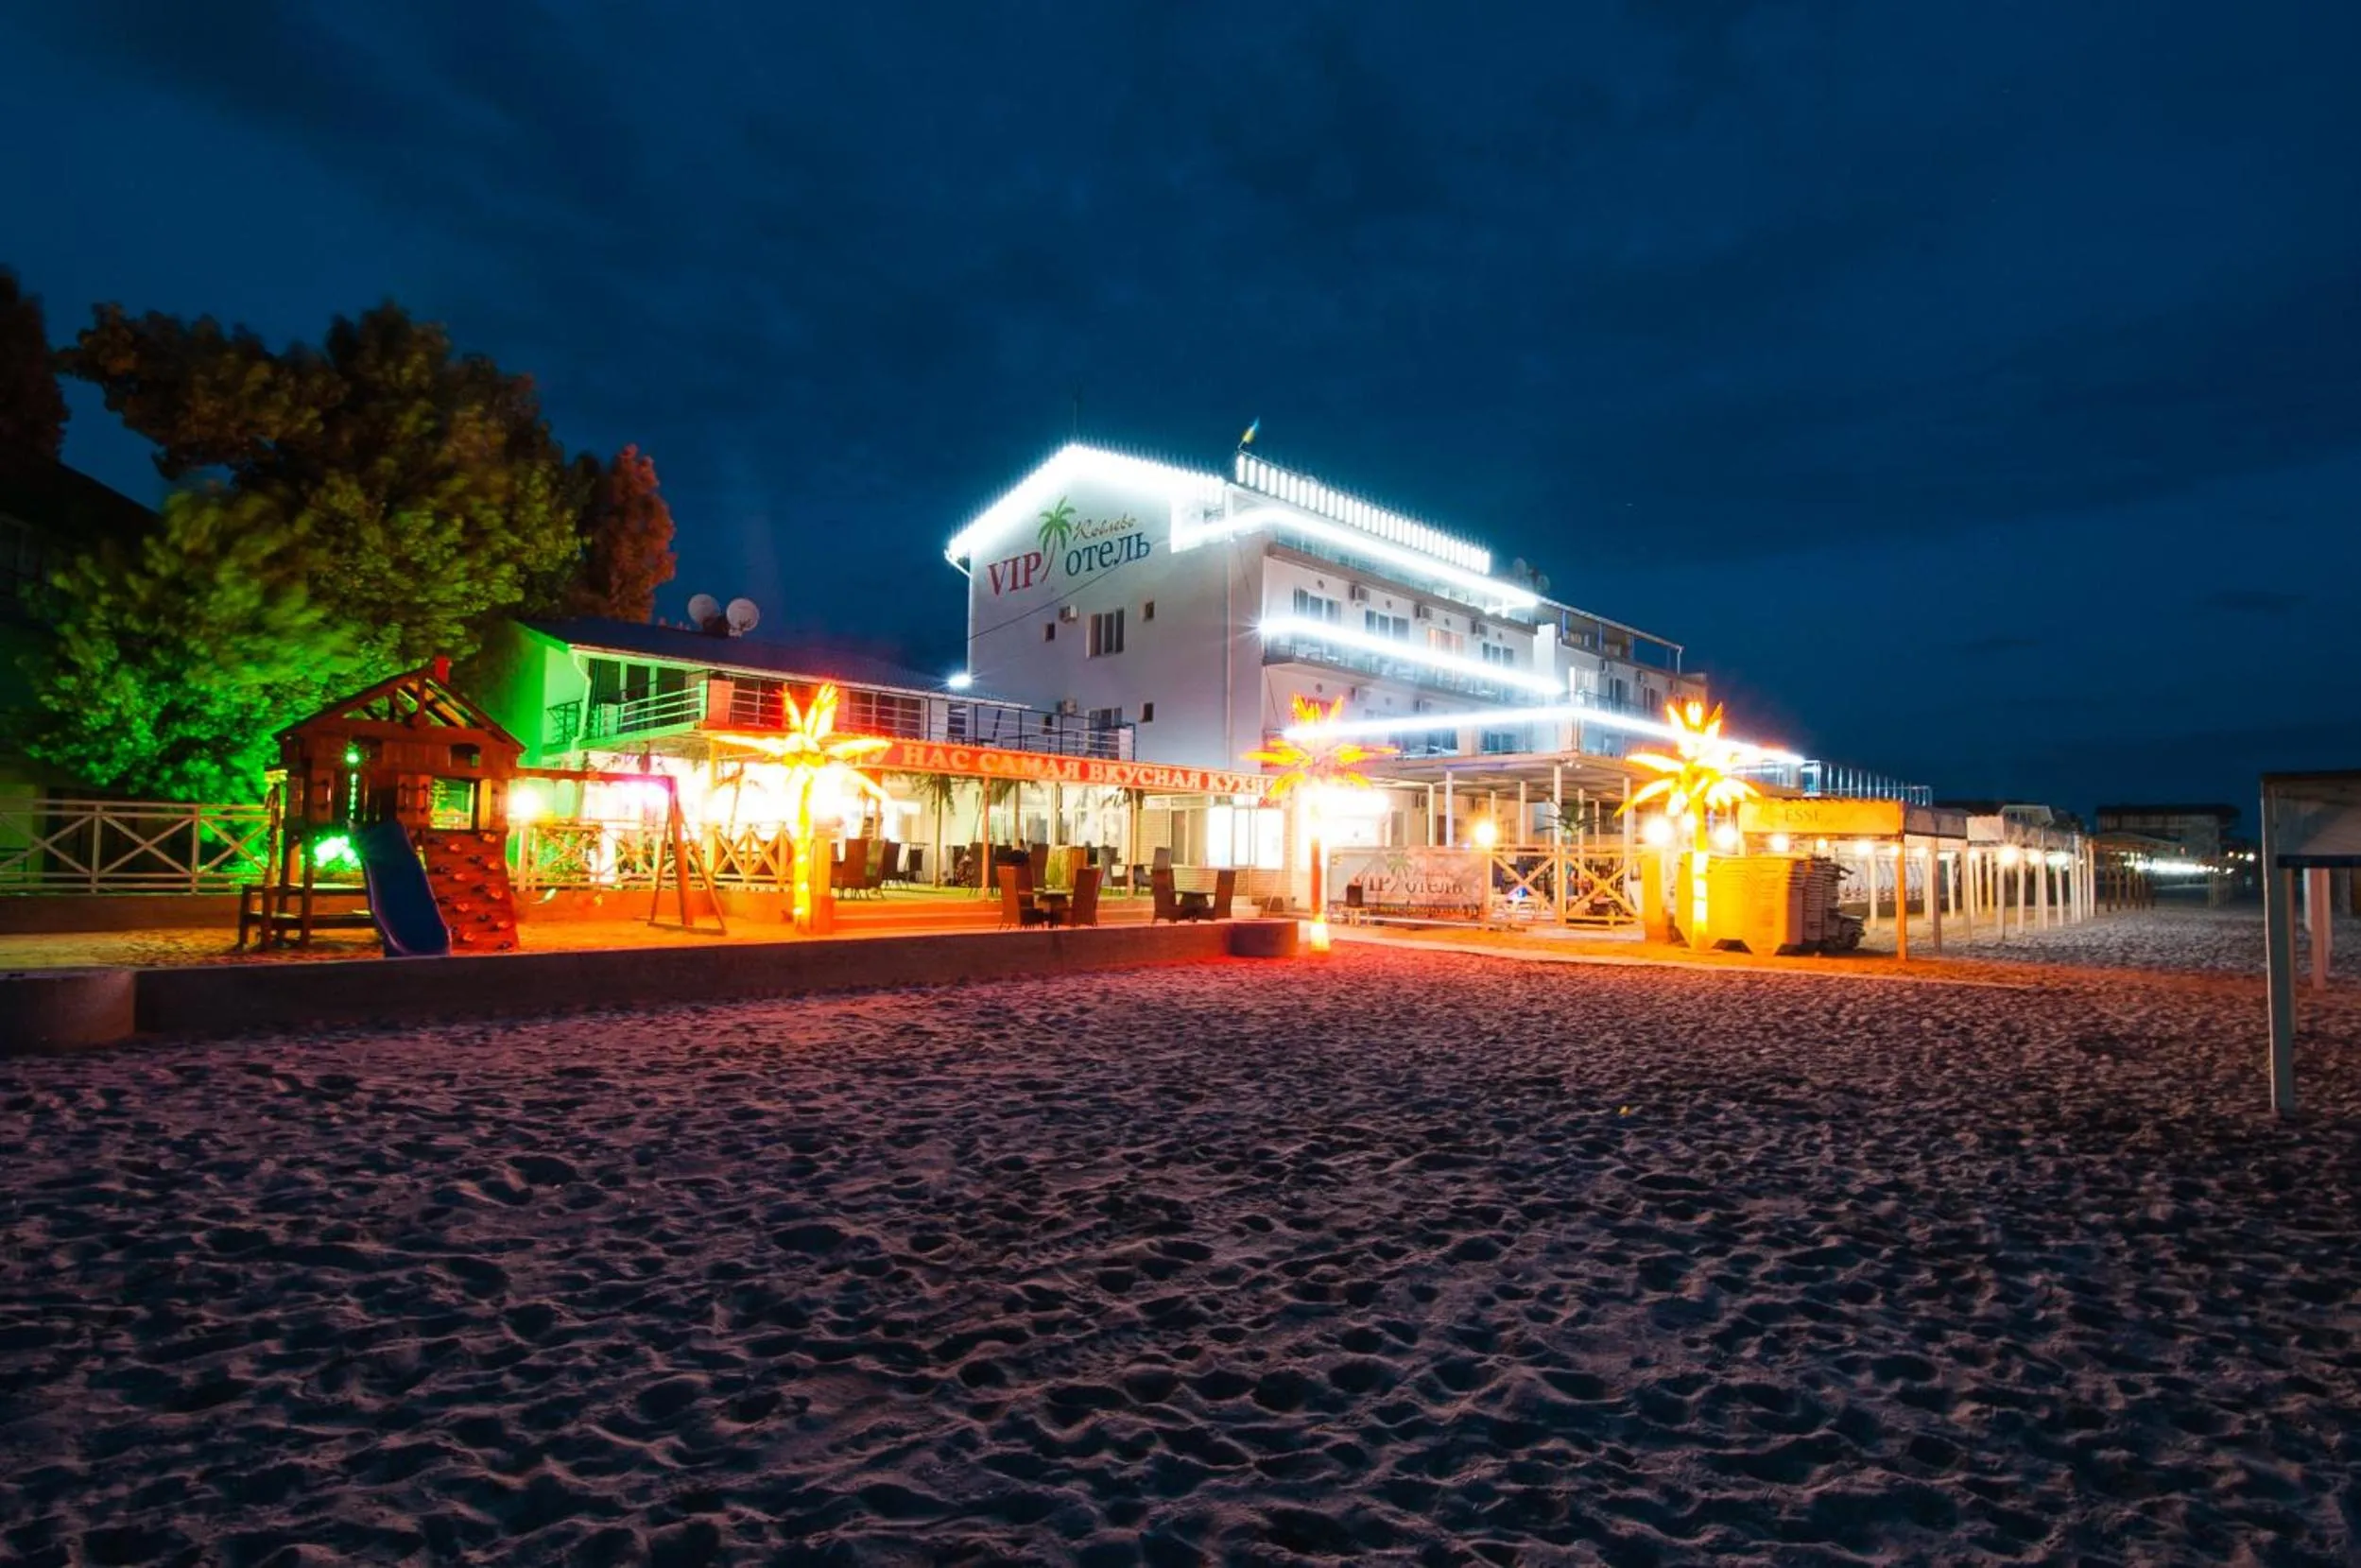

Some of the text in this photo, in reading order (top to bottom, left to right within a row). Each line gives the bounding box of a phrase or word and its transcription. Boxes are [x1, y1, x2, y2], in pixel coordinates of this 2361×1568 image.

[988, 551, 1042, 595] VIP
[901, 744, 971, 770] НАС
[978, 752, 1081, 781] САМАЯ
[1088, 763, 1201, 790] ВКУСНАЯ
